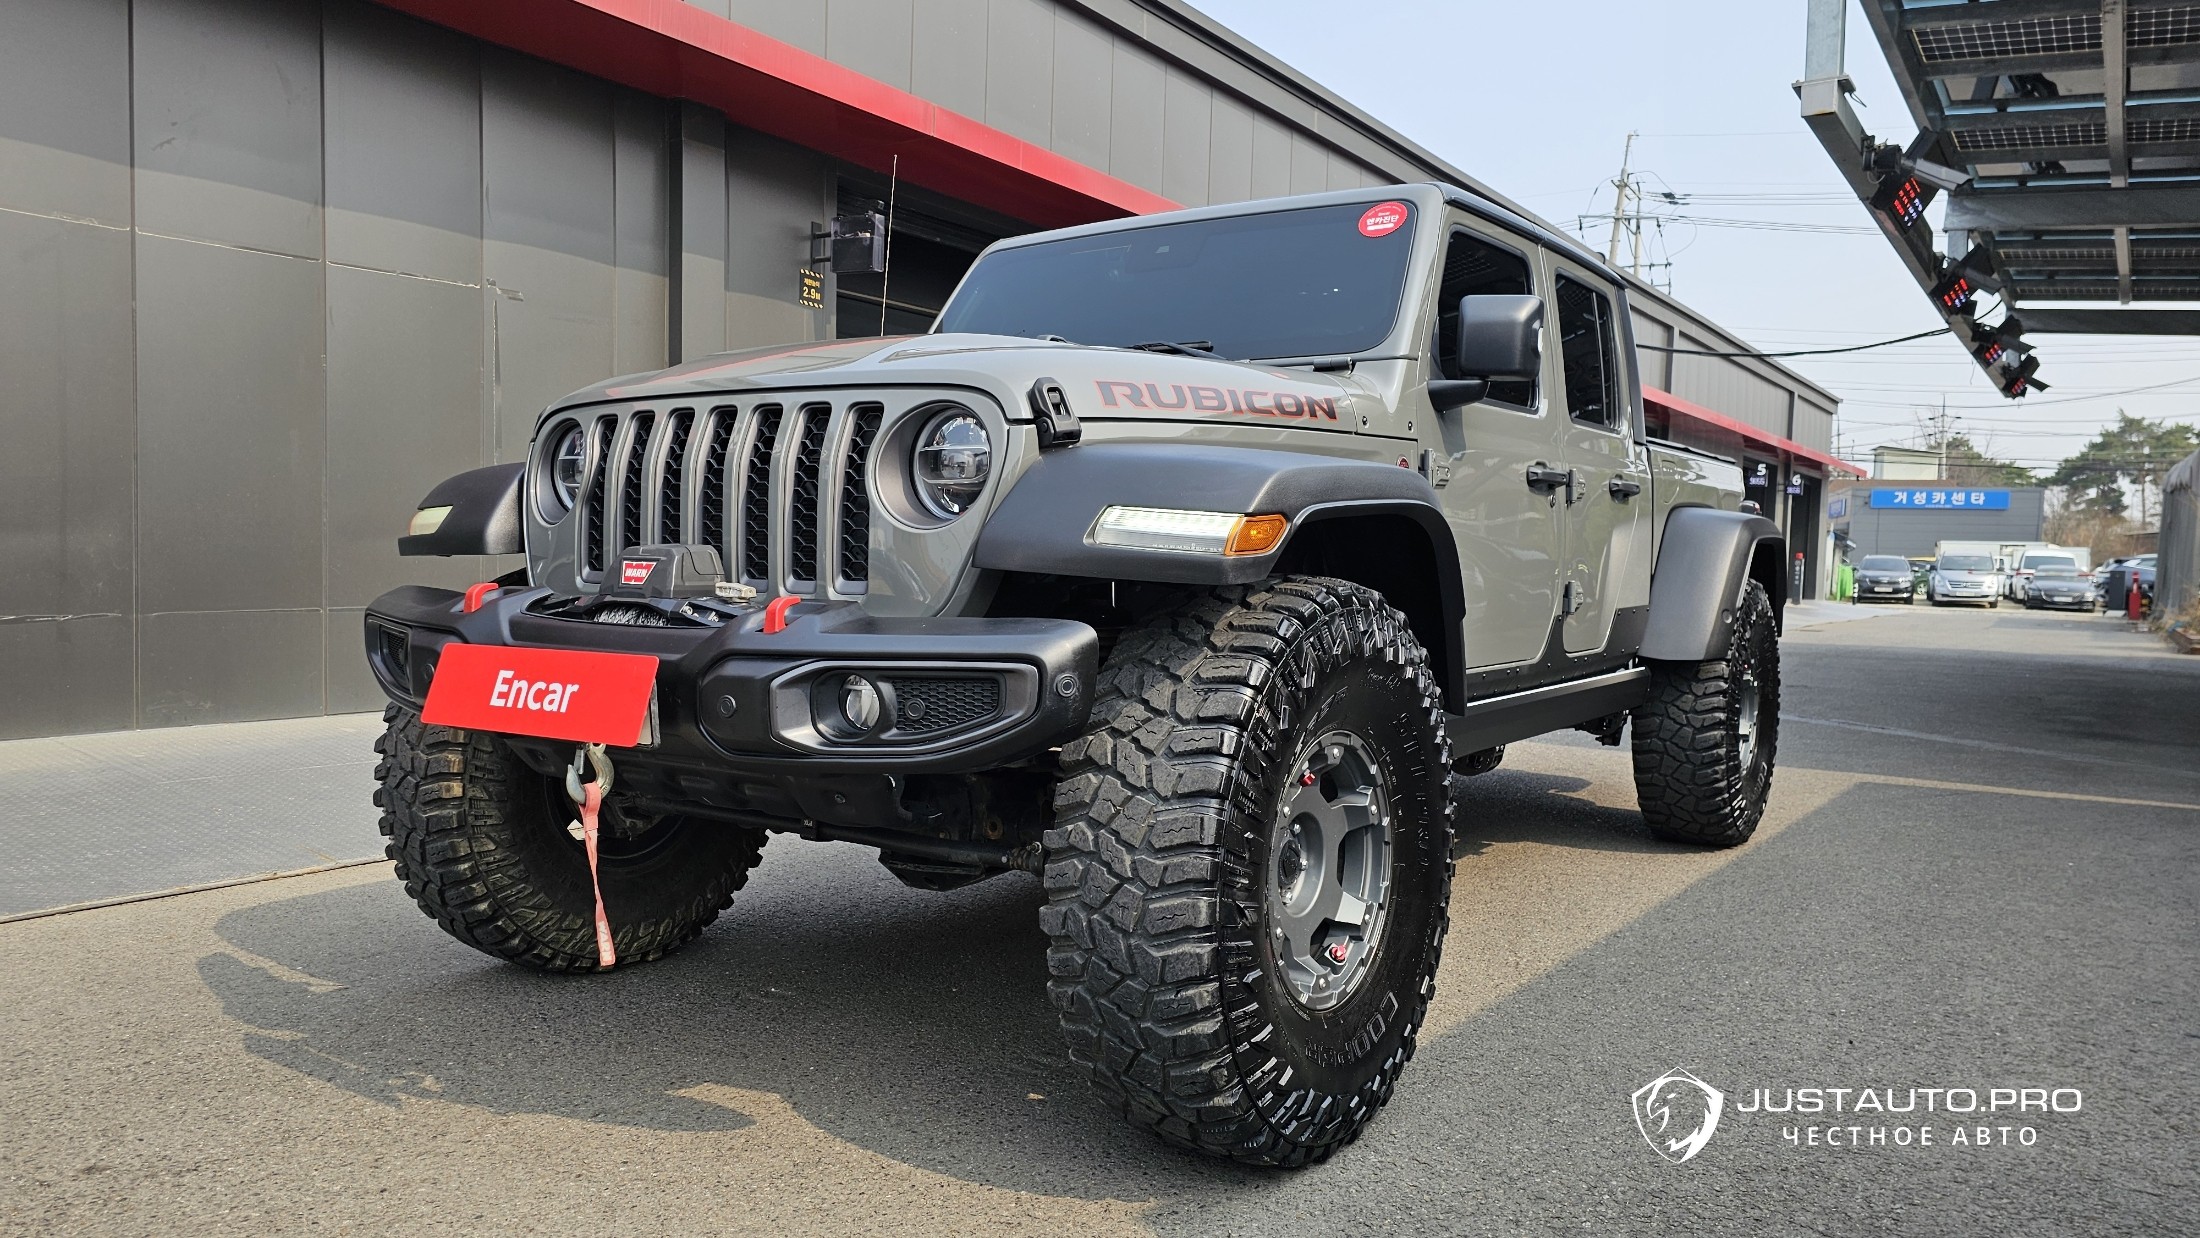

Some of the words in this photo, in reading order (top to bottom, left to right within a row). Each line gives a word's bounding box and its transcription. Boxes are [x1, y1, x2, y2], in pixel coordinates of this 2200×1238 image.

[1095, 380, 1338, 421] RUBICON
[1757, 463, 1767, 476] 5
[1792, 474, 1802, 486] 6
[1893, 491, 1986, 506] 거성카센타
[624, 567, 648, 578] WARN
[489, 669, 580, 713] Encar
